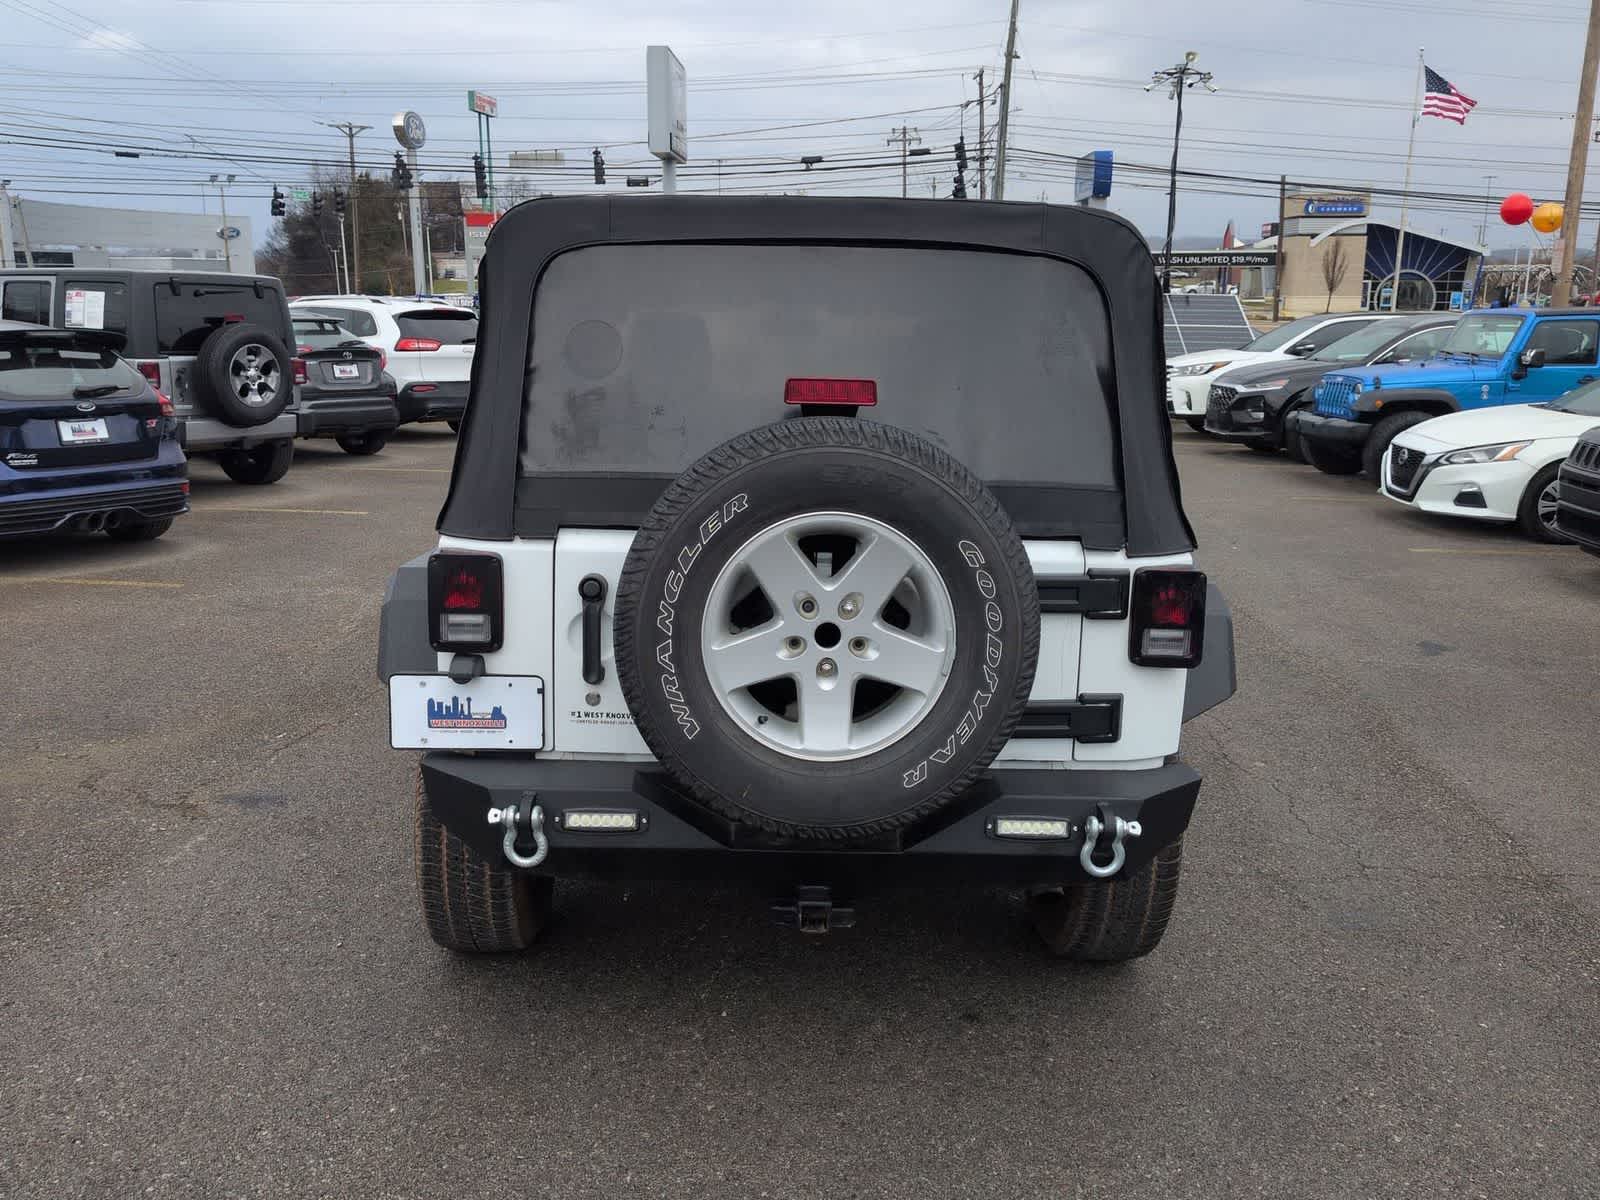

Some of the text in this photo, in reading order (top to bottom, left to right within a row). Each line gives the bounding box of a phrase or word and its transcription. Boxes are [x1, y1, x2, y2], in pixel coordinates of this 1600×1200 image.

[1184, 256, 1230, 264] UNLIMITED
[656, 493, 749, 740] WRANGLER
[903, 540, 1003, 789] GOODYEAR
[583, 711, 604, 719] WEST
